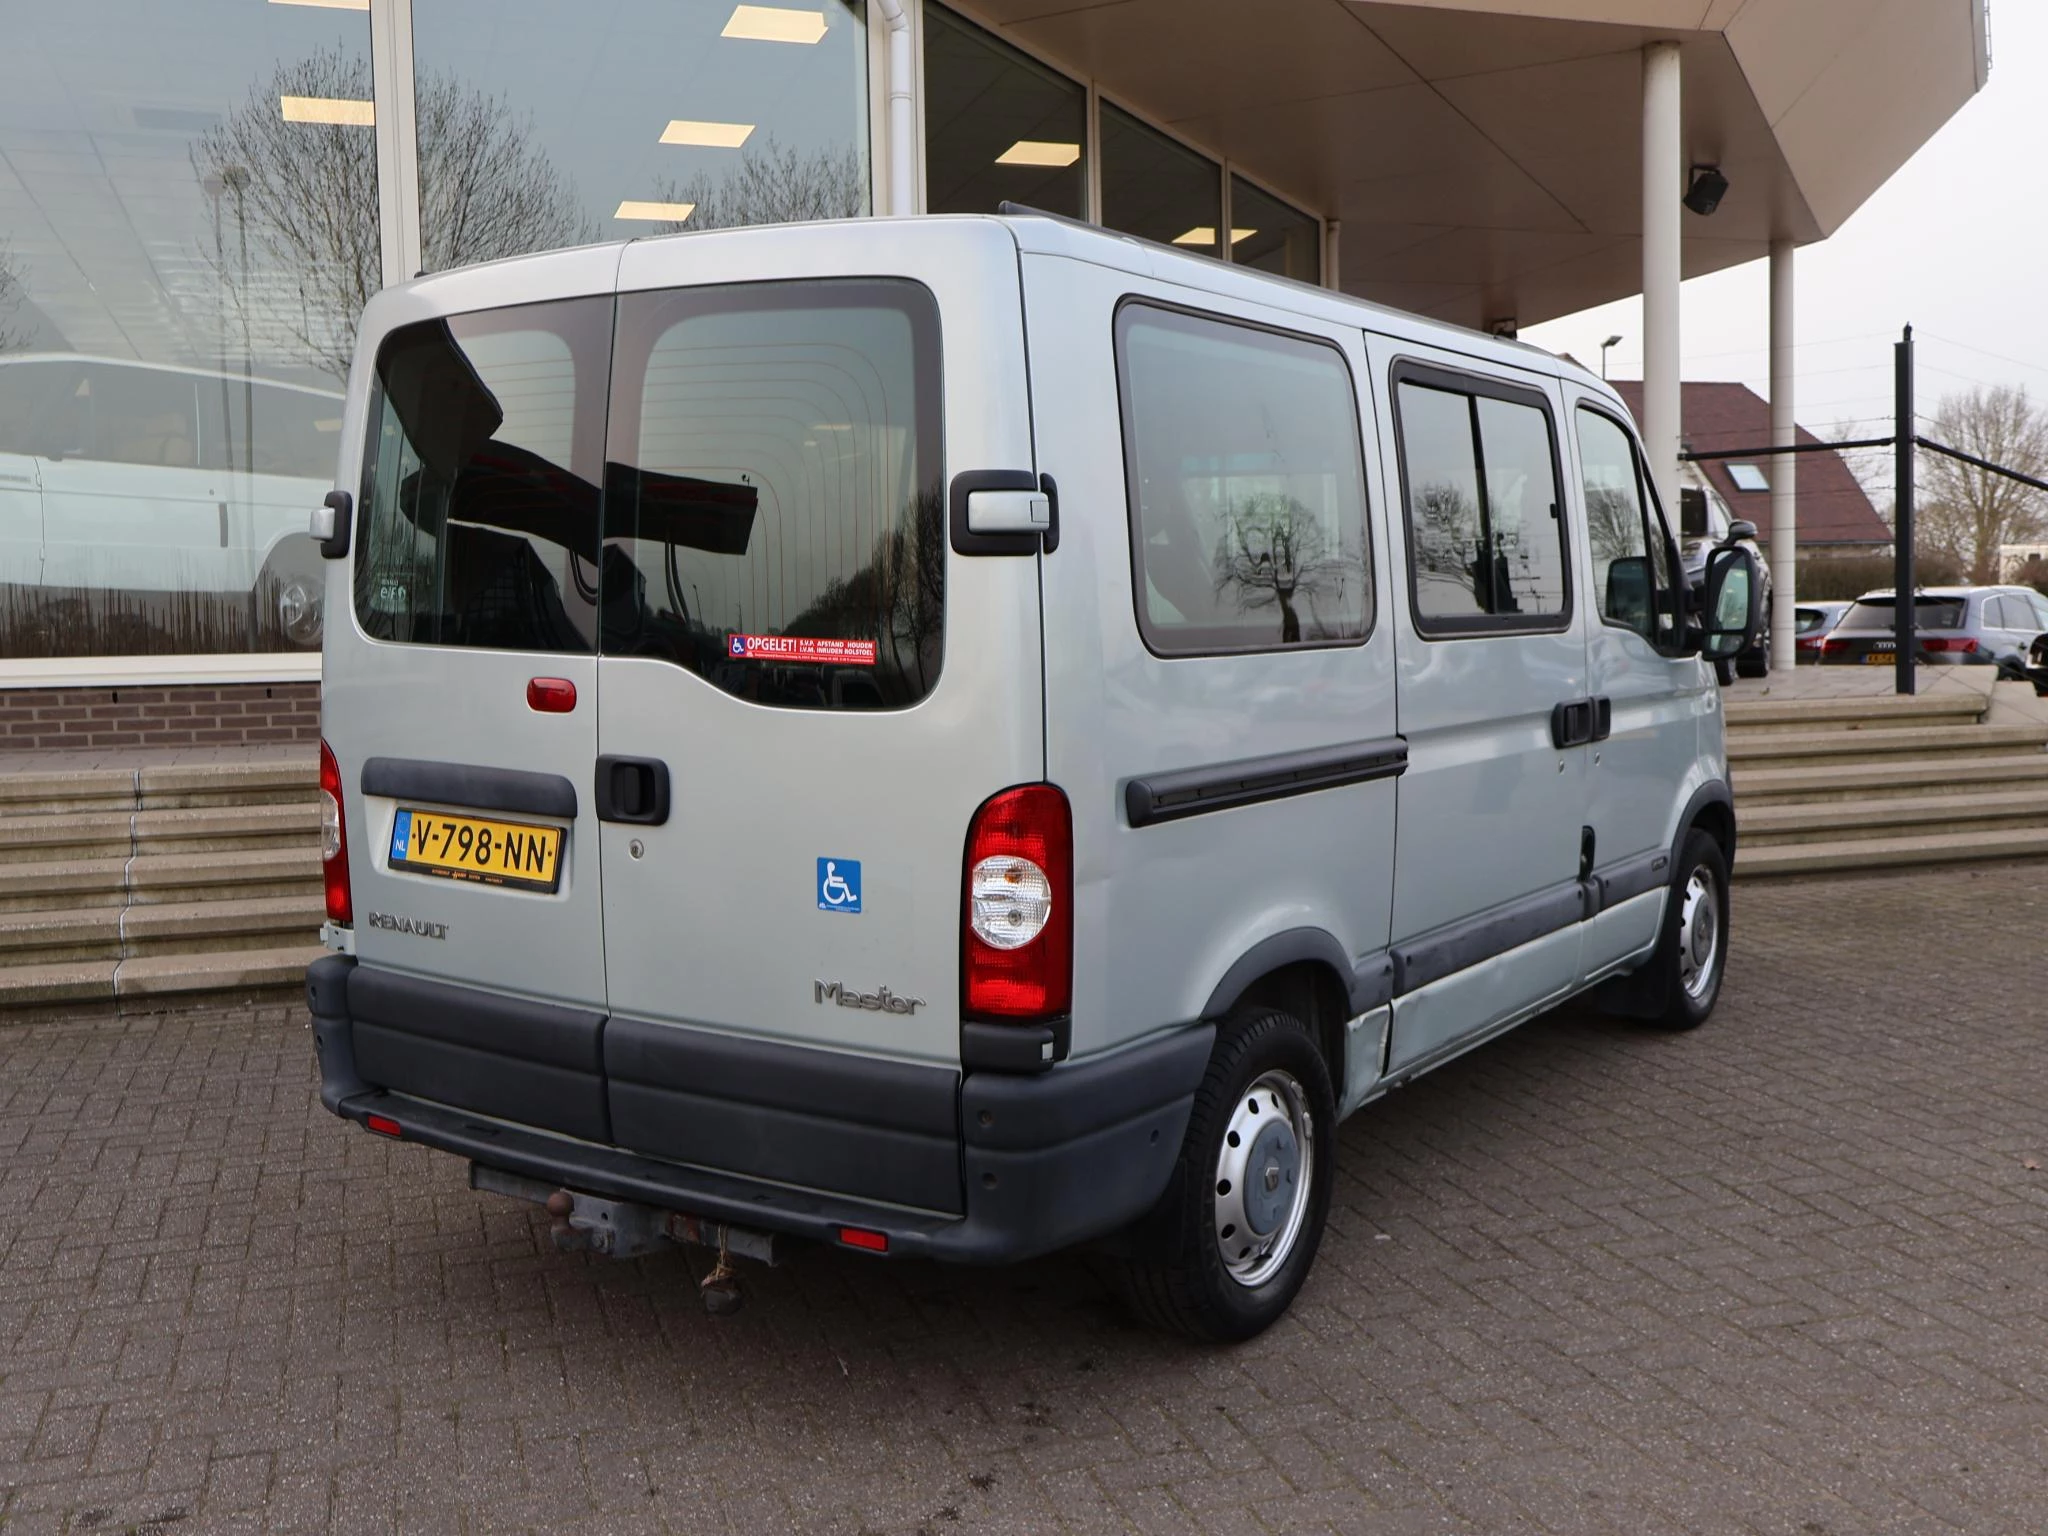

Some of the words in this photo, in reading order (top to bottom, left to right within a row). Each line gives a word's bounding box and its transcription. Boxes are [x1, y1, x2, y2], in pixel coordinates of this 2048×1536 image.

[746, 637, 797, 652] OPGELET!
[817, 640, 845, 648] AFSTAND
[847, 641, 873, 649] HOUDEN
[844, 648, 874, 656] ROLSTOEL
[395, 839, 406, 852] NL
[416, 819, 547, 873] V-798-NN
[368, 911, 449, 940] RENAULT
[814, 978, 927, 1016] Master
